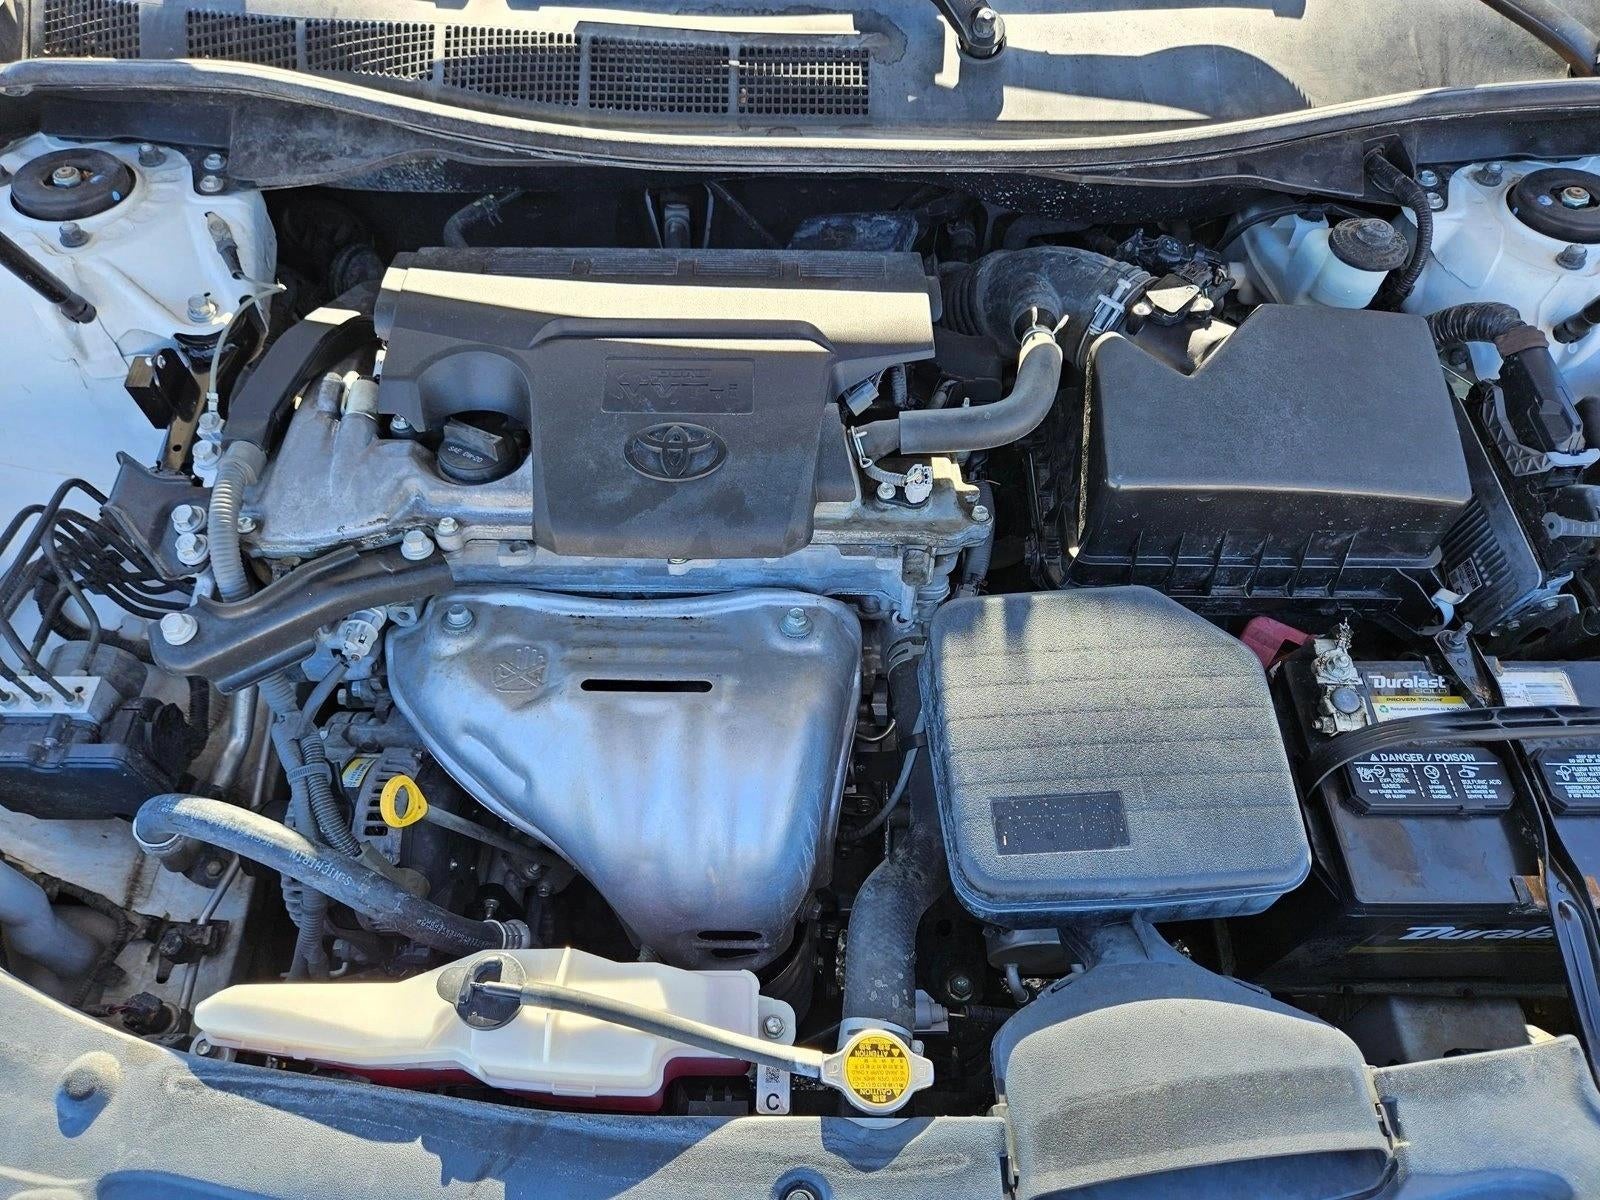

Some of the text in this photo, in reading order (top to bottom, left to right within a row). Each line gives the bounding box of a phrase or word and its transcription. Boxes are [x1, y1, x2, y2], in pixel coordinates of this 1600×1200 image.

[1368, 675, 1446, 689] Duralast
[1380, 753, 1476, 762] DANGER / POISON
[1398, 925, 1554, 940] Durala
[855, 1049, 889, 1057] ATTENTION
[860, 1088, 892, 1096] CAUTION
[765, 1092, 780, 1111] C
